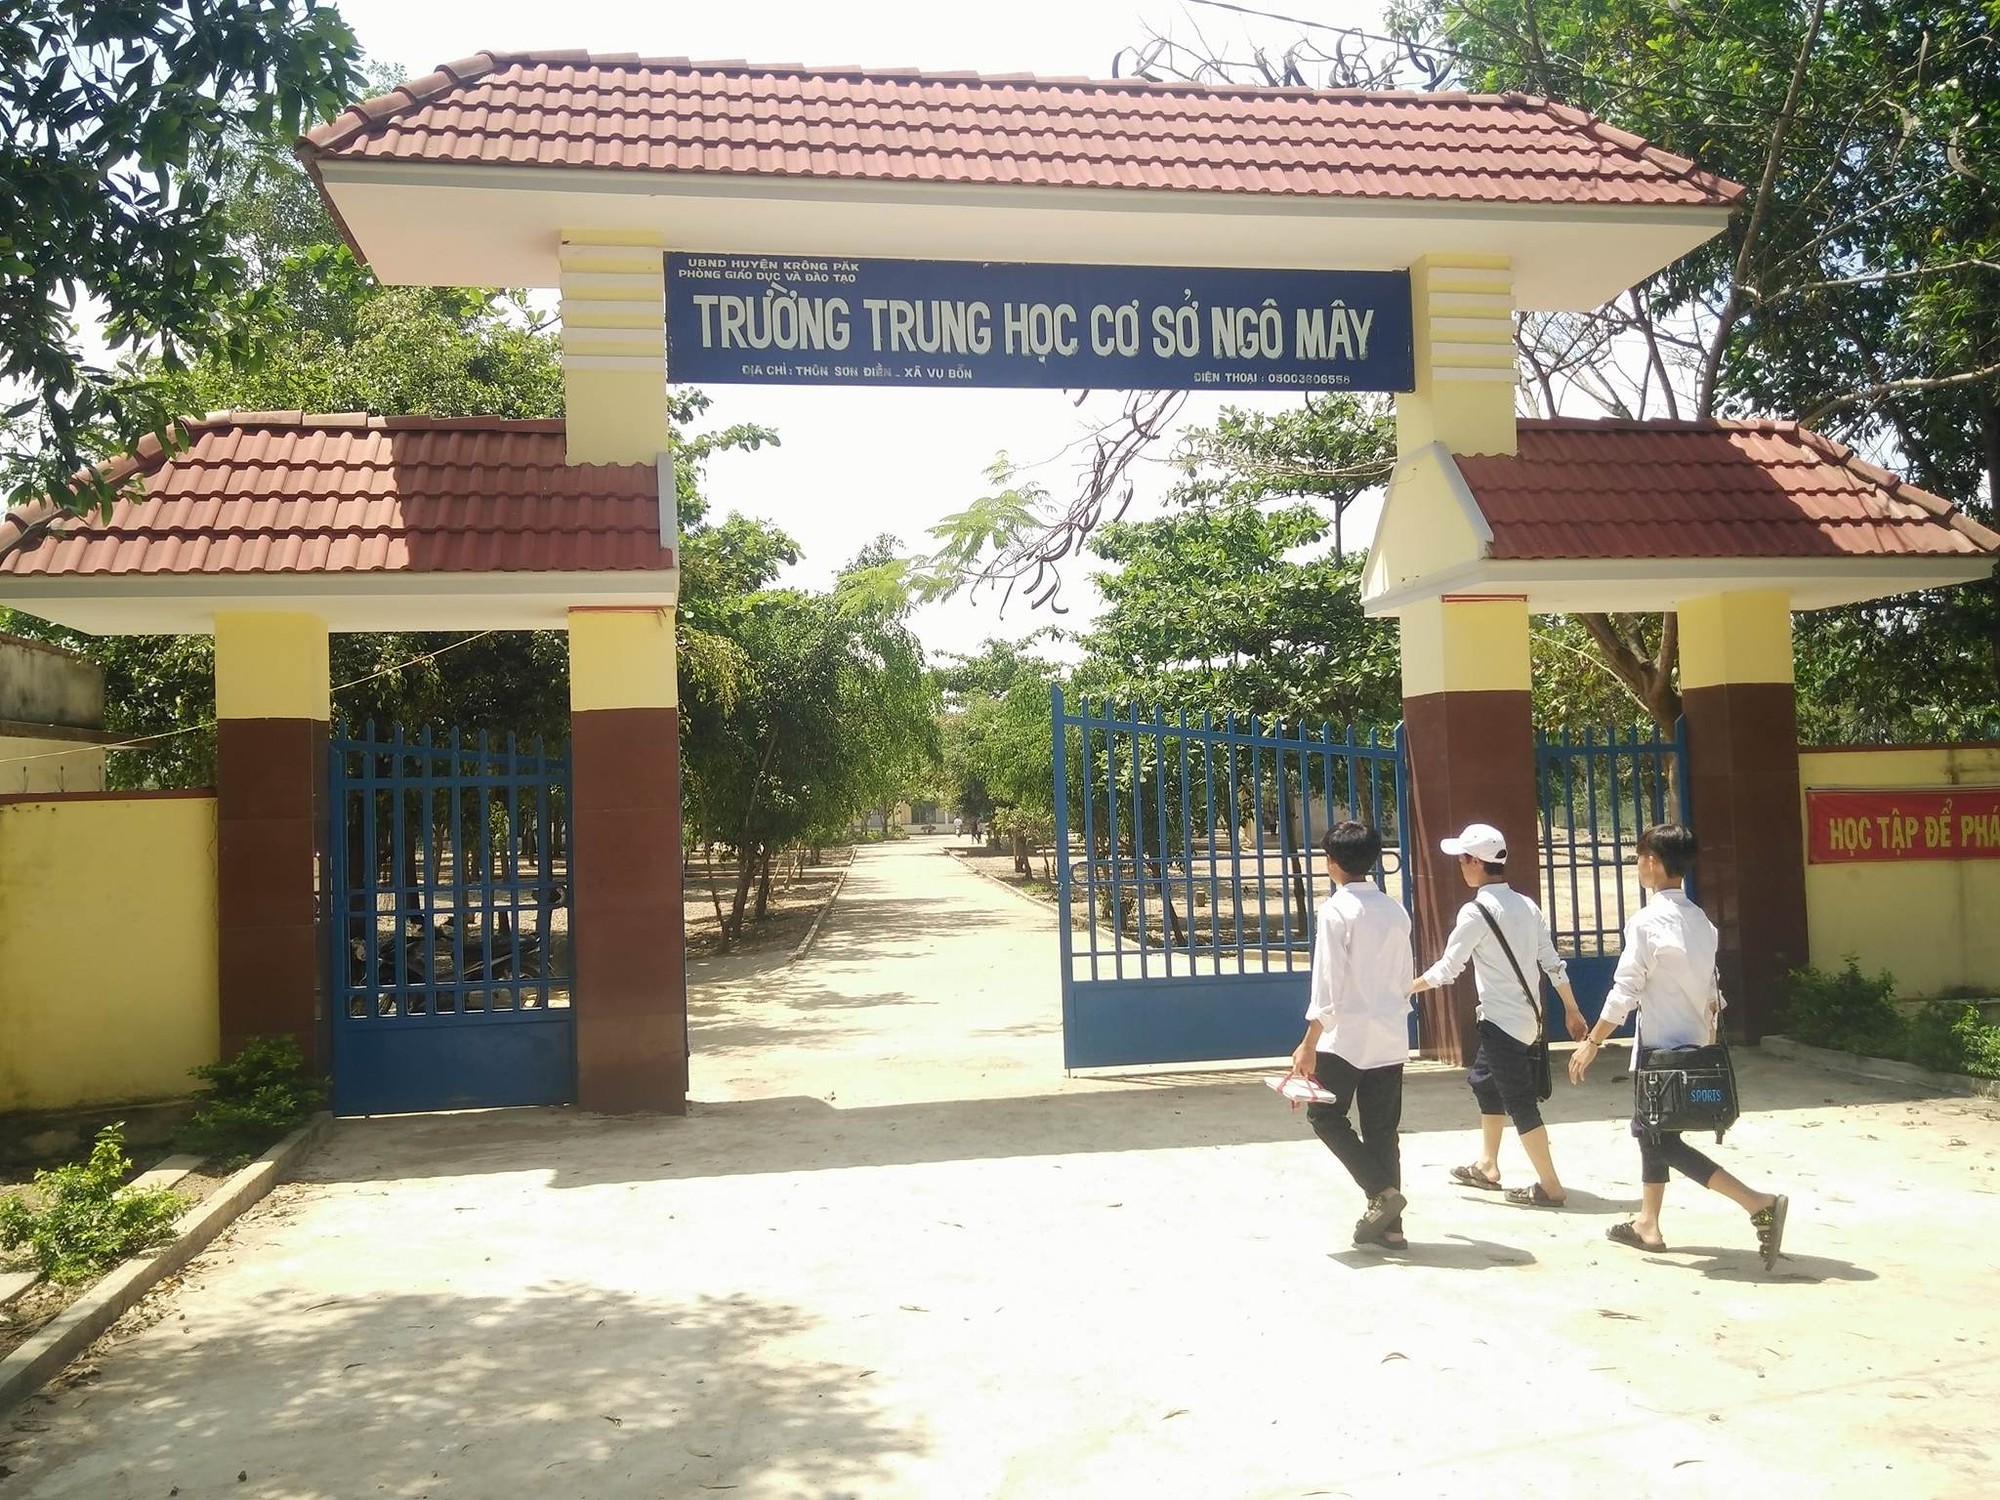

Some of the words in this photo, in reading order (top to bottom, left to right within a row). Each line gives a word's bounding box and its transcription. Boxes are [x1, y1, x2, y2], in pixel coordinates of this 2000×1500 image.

[688, 258, 727, 269] UBND
[731, 258, 778, 271] HUYỆN
[783, 260, 828, 272] KRÔNG
[678, 268, 721, 279] PHÒNG
[725, 269, 753, 280] GIÁO
[756, 272, 781, 283] DỤC
[785, 272, 802, 282] VÀ
[805, 272, 829, 282] ĐÀO
[833, 274, 856, 284] TẠO
[693, 281, 850, 351] TRƯỜNG
[863, 299, 992, 354] TRUNG
[1004, 302, 1079, 367] HỌC
[1090, 299, 1141, 357] CƠ
[1151, 288, 1201, 358] SỞ
[1211, 298, 1284, 360] NGÔ
[1295, 299, 1375, 360] MÂY
[742, 365, 763, 377] ĐỊA
[795, 364, 829, 377] THÔN
[904, 365, 922, 378] XÃ
[927, 367, 944, 380] VỤ
[1829, 816, 1872, 857] HỌC
[1876, 808, 1919, 856] TẬP
[1924, 798, 1953, 849] ĐỂ
[1690, 1089, 1721, 1102] SPORTS
